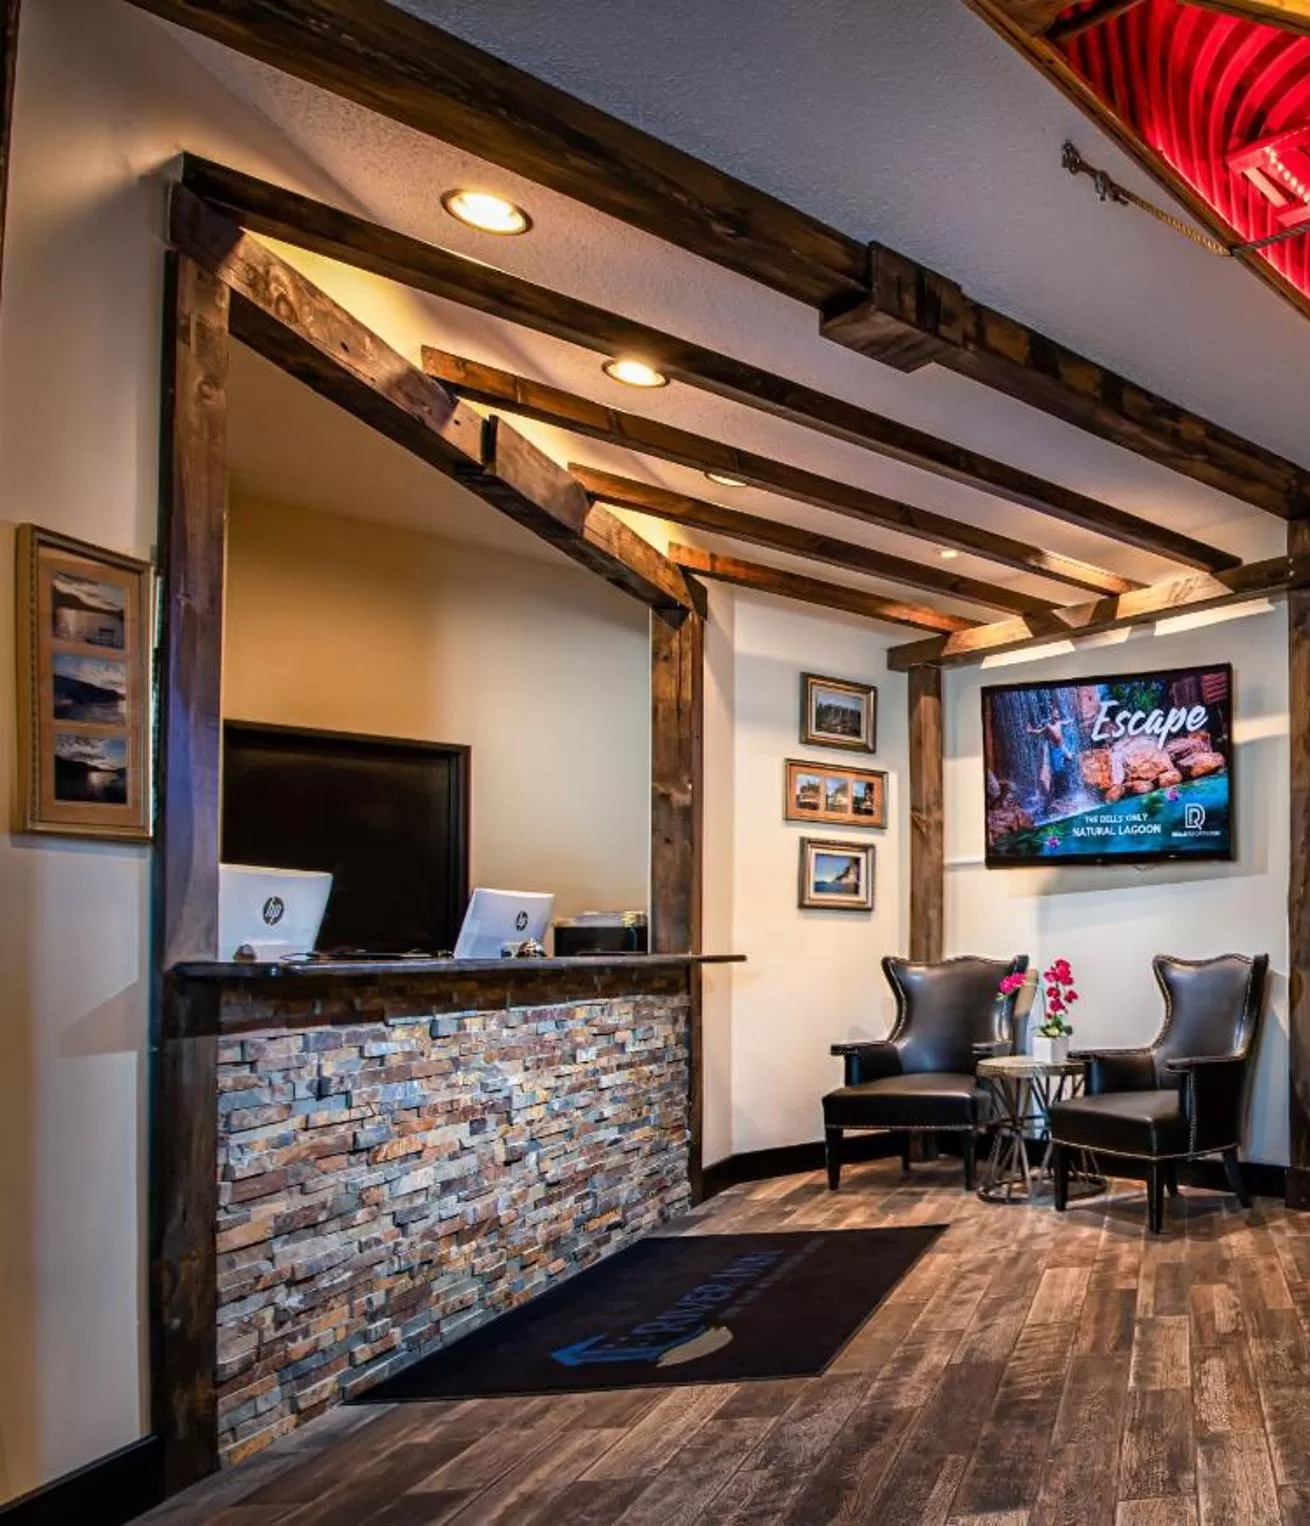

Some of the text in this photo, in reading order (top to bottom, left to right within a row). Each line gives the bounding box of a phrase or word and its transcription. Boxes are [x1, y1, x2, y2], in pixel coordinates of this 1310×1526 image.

[1091, 699, 1208, 750] Escape
[1125, 812, 1149, 822] ONLY
[1072, 826, 1116, 837] NATURAL
[1118, 823, 1162, 836] LAGOON
